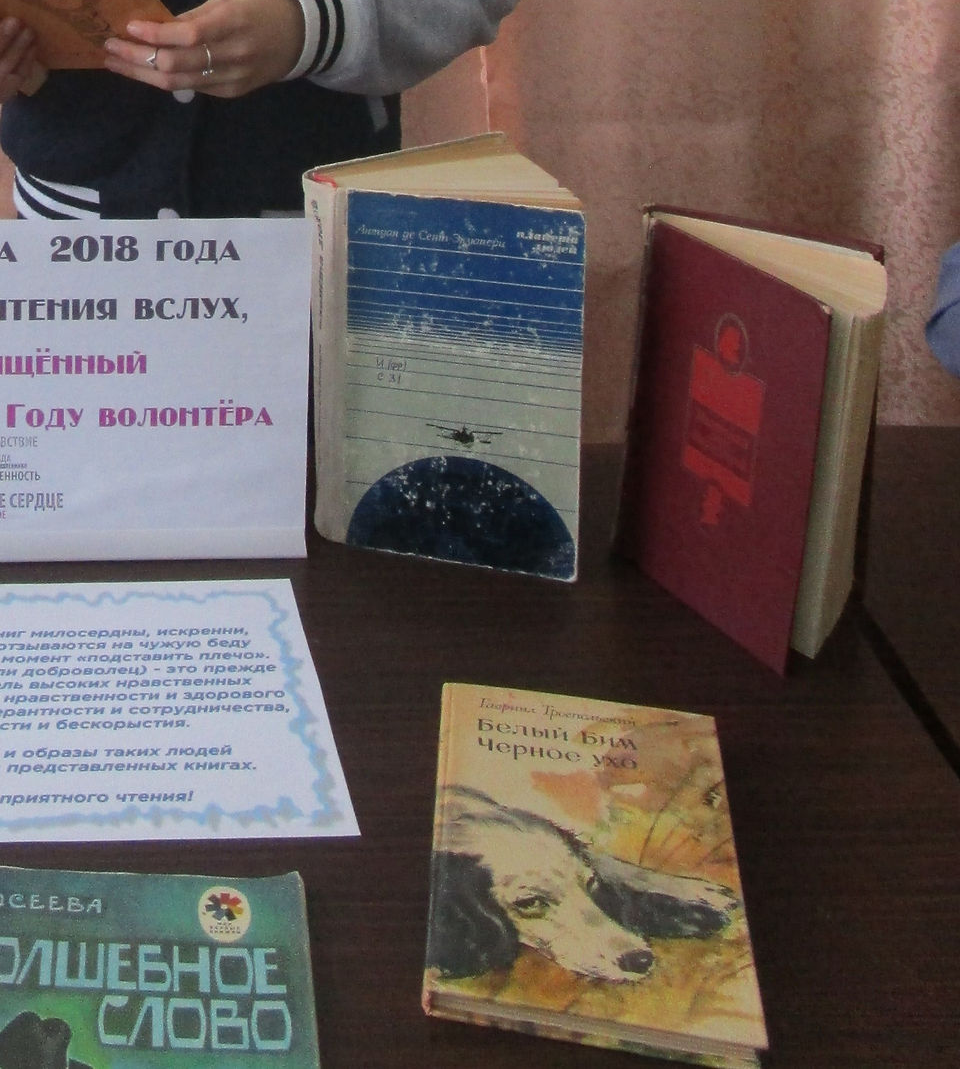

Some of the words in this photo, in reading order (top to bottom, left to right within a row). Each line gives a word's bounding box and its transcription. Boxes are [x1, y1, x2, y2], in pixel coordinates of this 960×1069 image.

[50, 235, 139, 263] 2018
[9, 492, 64, 511] СЕРДЦЕ
[30, 628, 151, 639] милосердны,
[156, 626, 250, 637] искренни,
[112, 641, 134, 650] на
[139, 639, 202, 650] чужую
[207, 637, 252, 649] беду
[1, 654, 72, 663] момент
[76, 653, 194, 663] «подставить
[198, 651, 270, 661] плечо».
[21, 664, 148, 677] доброволец)
[166, 664, 198, 674] это
[202, 663, 278, 675] прежде
[28, 680, 110, 690] высоких
[115, 677, 253, 689] нравственных
[3, 691, 160, 705] нравственности
[165, 692, 178, 700] и
[183, 689, 286, 701] здорового
[110, 706, 123, 715] и
[128, 702, 291, 715] сотрудничества,
[37, 721, 50, 730] и
[55, 718, 191, 731] бескорыстия.
[477, 718, 569, 742] Белый
[581, 729, 638, 750] Бим
[3, 750, 16, 759] и
[21, 747, 98, 759] образы
[104, 747, 161, 757] таких
[164, 744, 233, 758] людей
[6, 761, 178, 775] представленных
[183, 760, 257, 771] книгах.
[592, 754, 638, 770] ухо
[115, 790, 194, 803] чтения!
[97, 995, 293, 1051] СЛОВО
